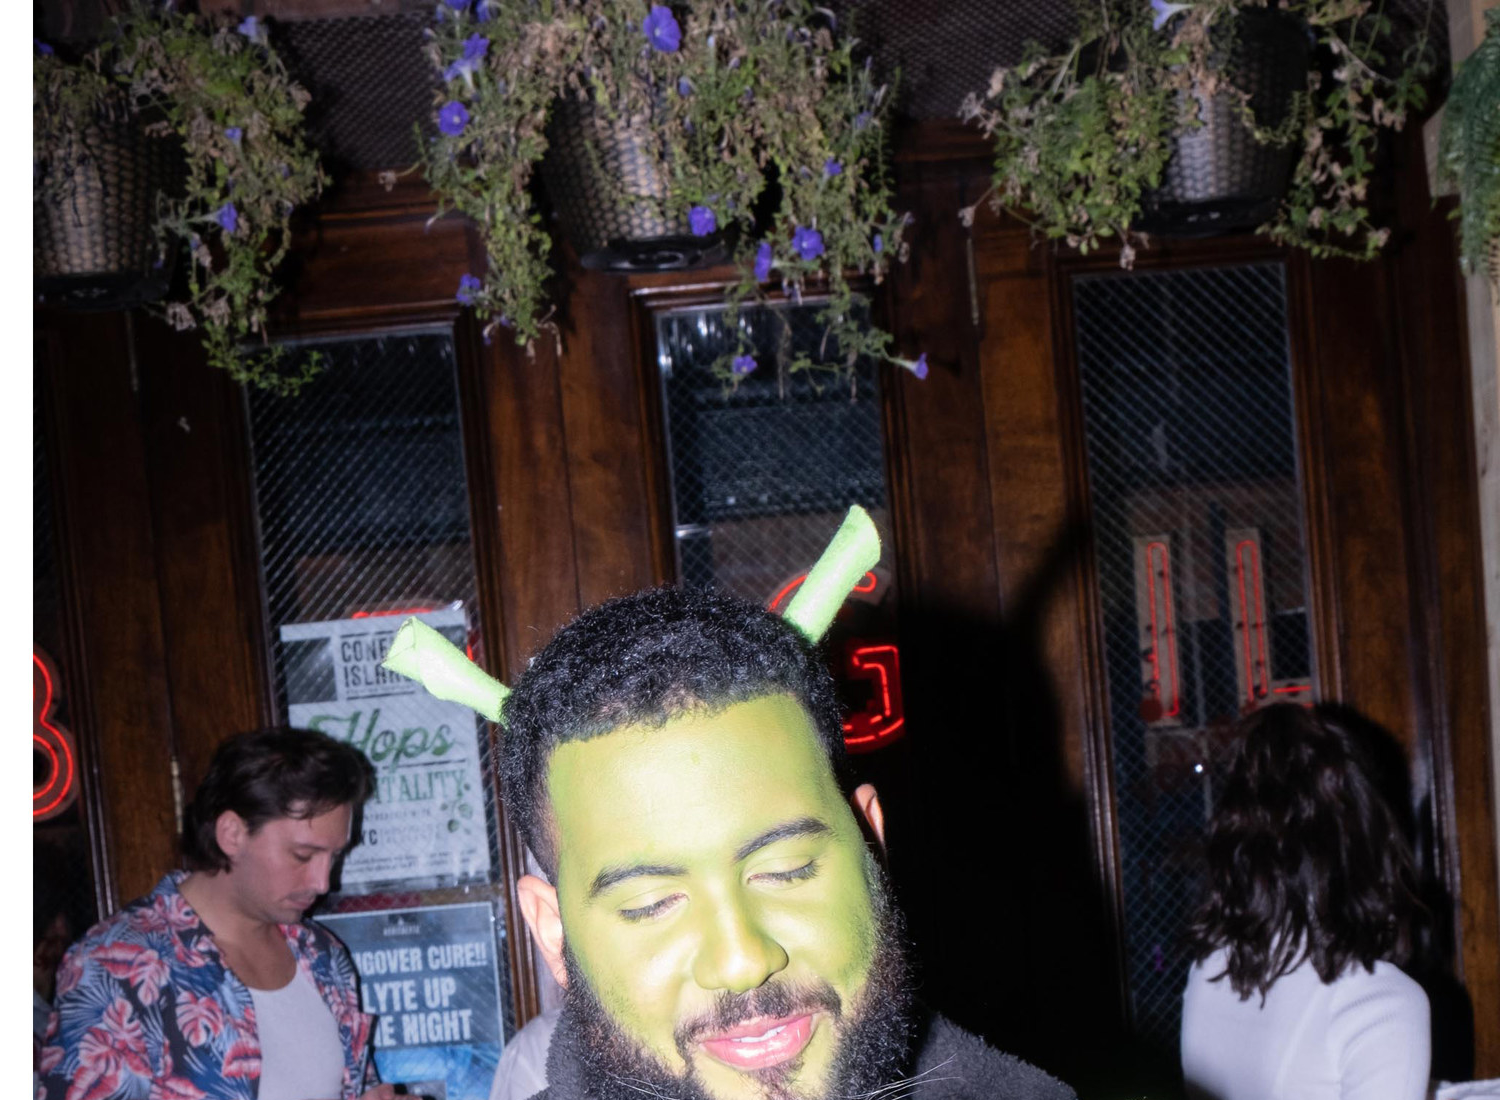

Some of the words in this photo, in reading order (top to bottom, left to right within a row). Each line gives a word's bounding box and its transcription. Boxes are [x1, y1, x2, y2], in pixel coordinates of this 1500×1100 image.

[341, 637, 396, 663] CONE
[343, 663, 413, 689] ISLAN
[307, 708, 460, 773] Hops
[427, 942, 488, 971] CURE!!
[424, 976, 456, 1008] UP
[401, 1009, 473, 1046] NIGHT
